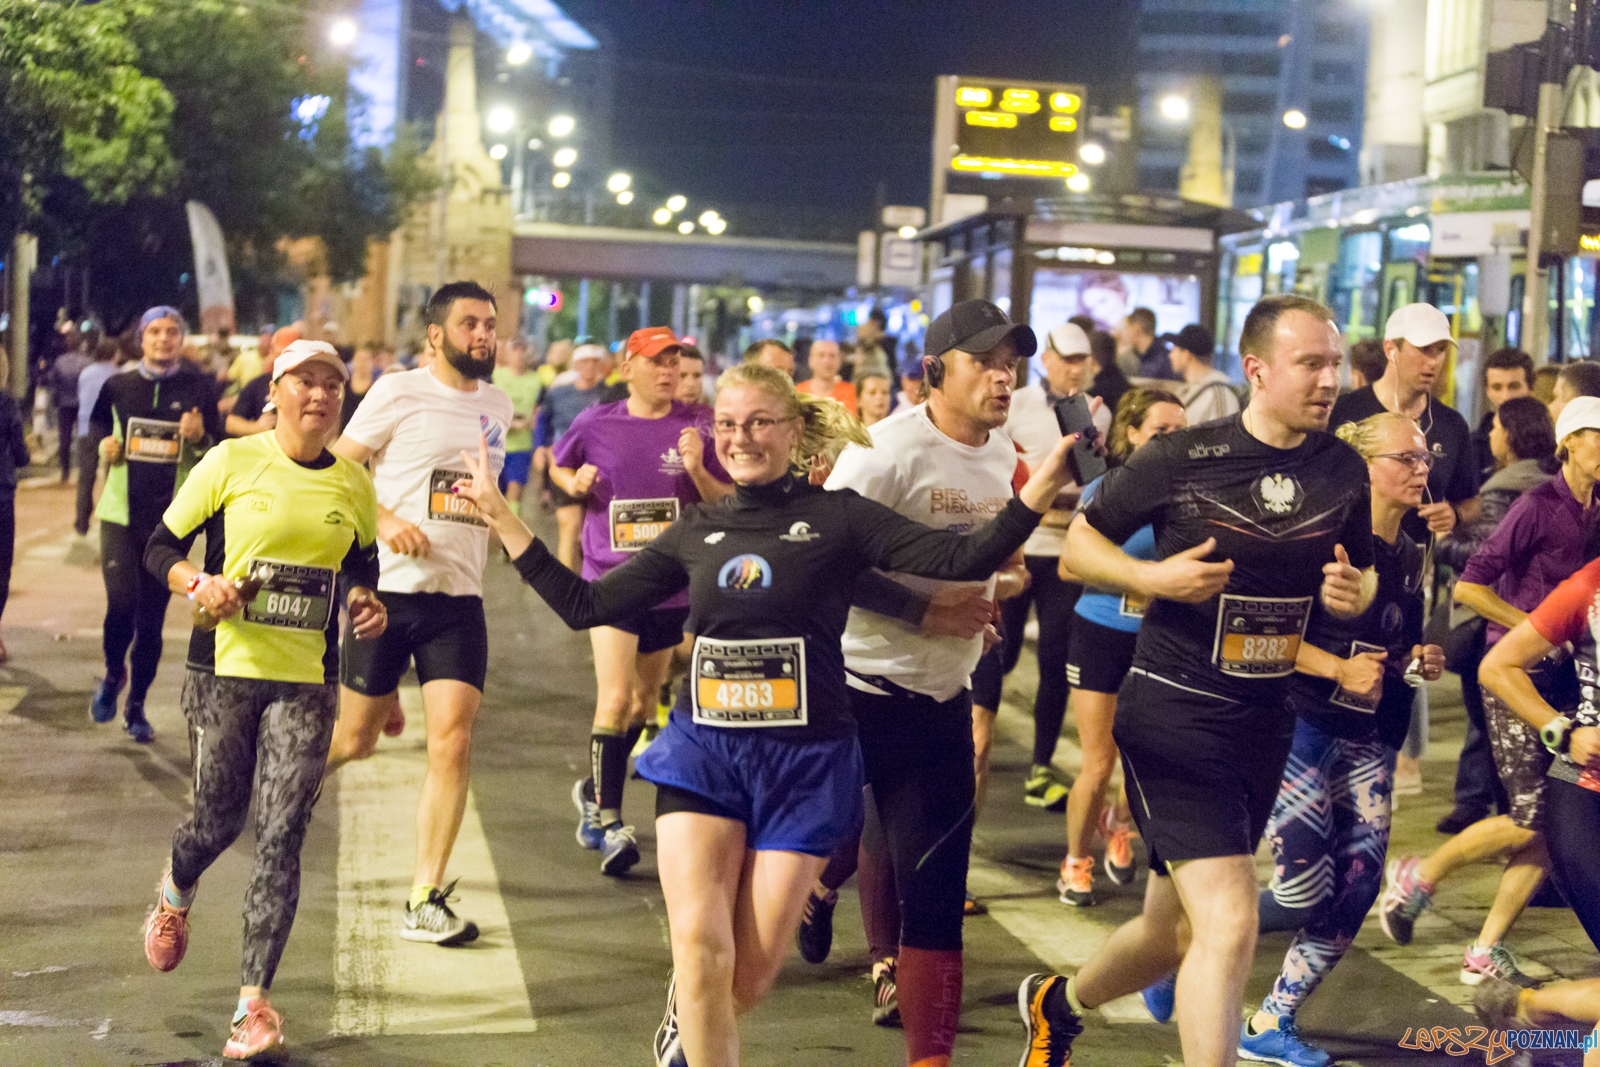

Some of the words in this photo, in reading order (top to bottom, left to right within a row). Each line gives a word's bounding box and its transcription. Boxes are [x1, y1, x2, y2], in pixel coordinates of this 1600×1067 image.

[266, 593, 312, 617] 6047
[1242, 637, 1289, 661] 8282
[715, 682, 774, 708] 4263
